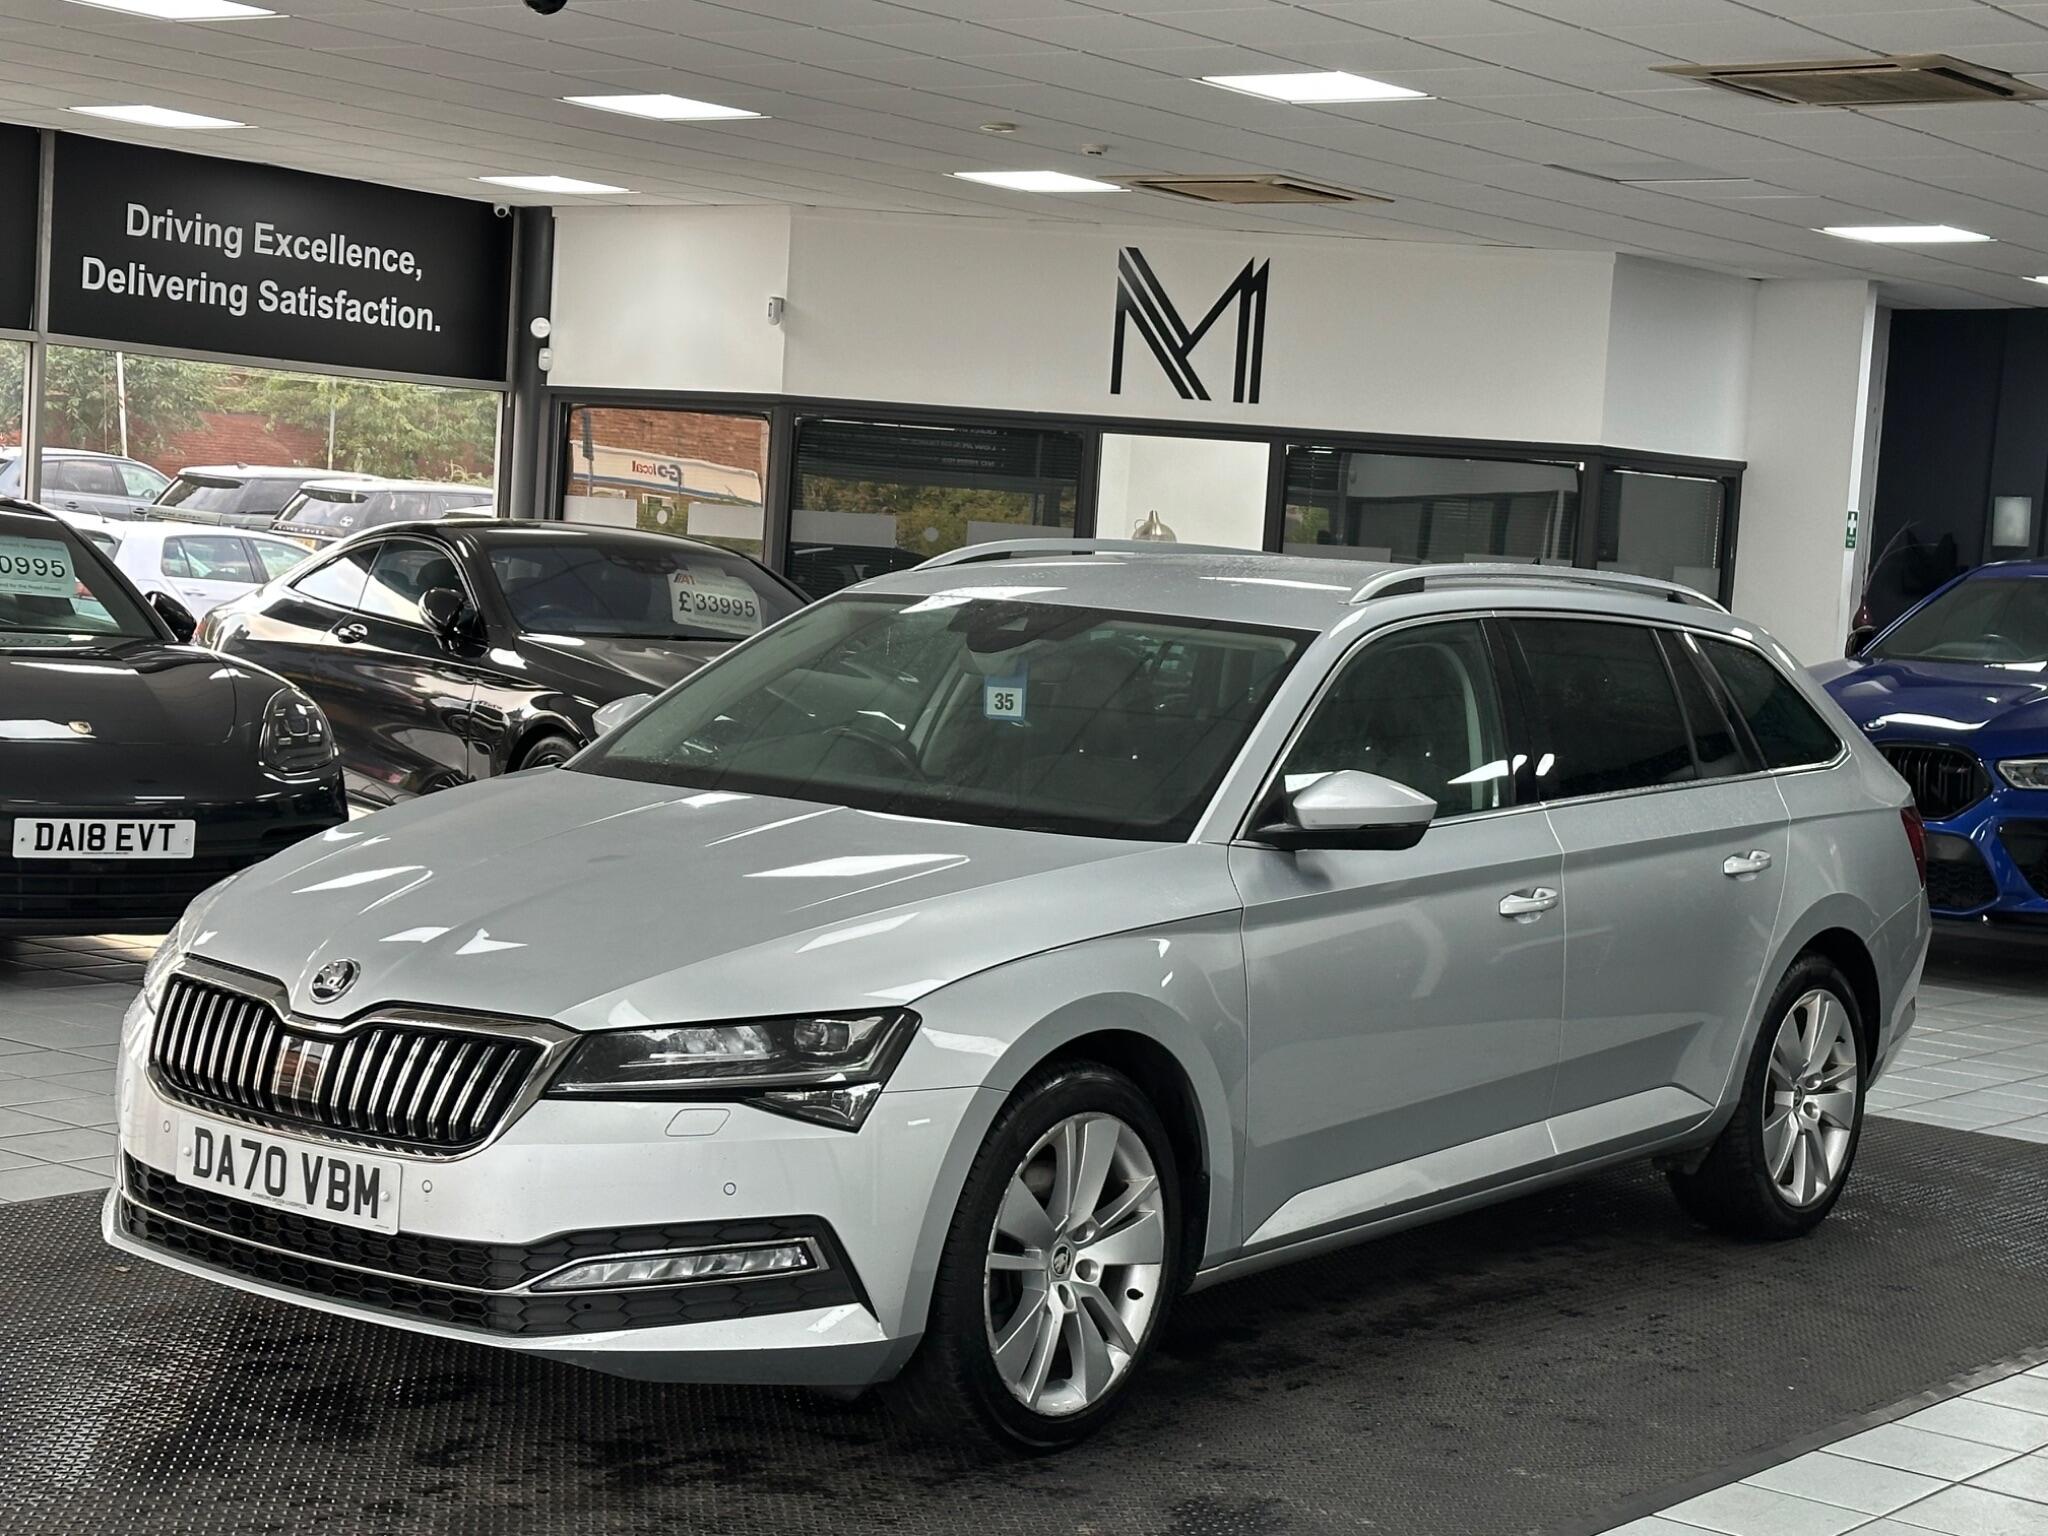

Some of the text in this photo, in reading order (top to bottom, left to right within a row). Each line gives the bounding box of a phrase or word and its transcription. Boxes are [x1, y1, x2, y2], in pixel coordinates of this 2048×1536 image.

[126, 203, 422, 281] Driving Excellence,
[81, 256, 441, 332] Delivering Satisfaction.
[0, 555, 66, 578] 0995
[994, 692, 1014, 711] 35
[34, 822, 176, 851] DA18 EVT
[193, 1126, 380, 1219] DA70 VBM
